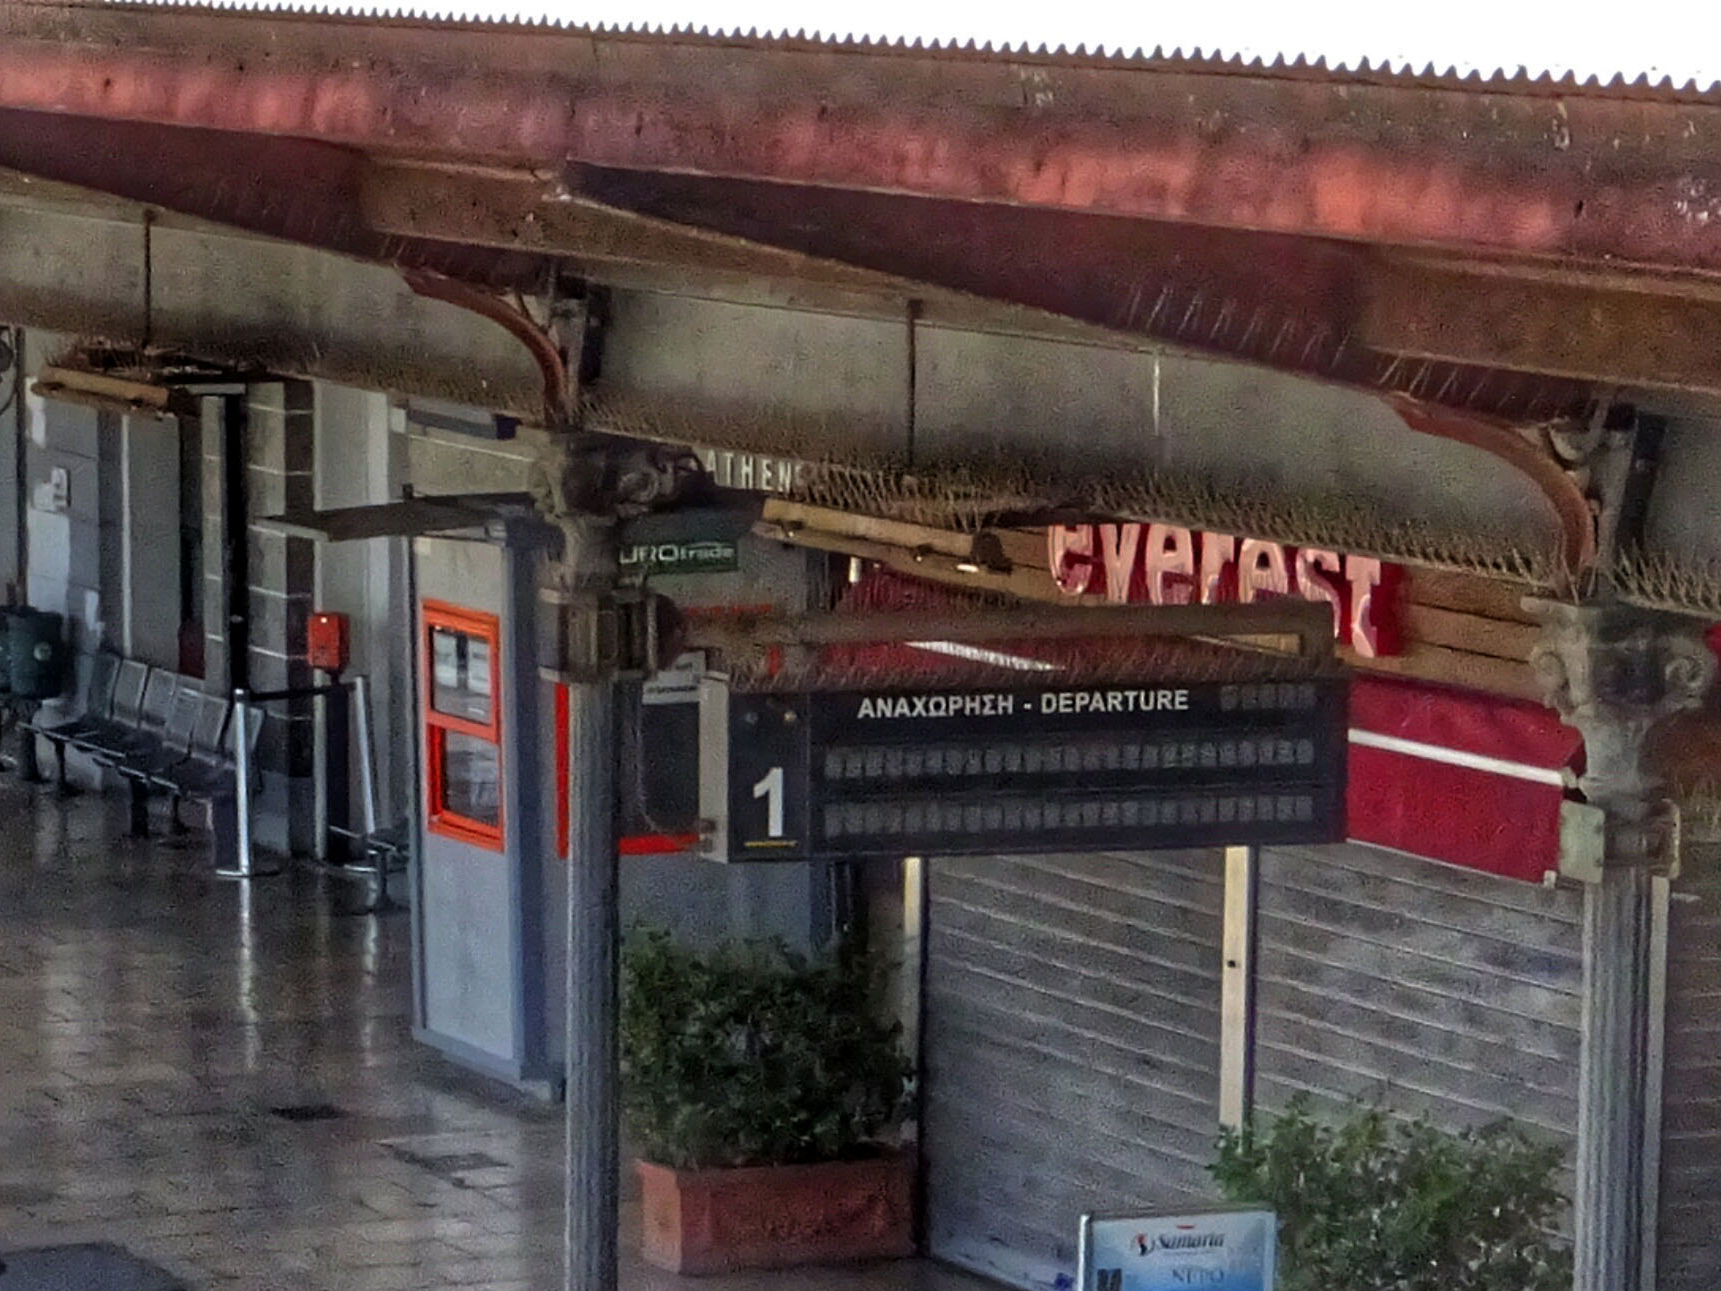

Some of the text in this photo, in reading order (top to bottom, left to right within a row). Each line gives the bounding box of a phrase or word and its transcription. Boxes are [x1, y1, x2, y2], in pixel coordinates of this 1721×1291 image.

[619, 541, 735, 565] UROtrade
[1048, 523, 1381, 658] everest
[857, 694, 1015, 719] ΑΝΑΧΩΡΗΣΗ
[1040, 689, 1189, 715] DEPARTURE
[752, 767, 784, 838] 1
